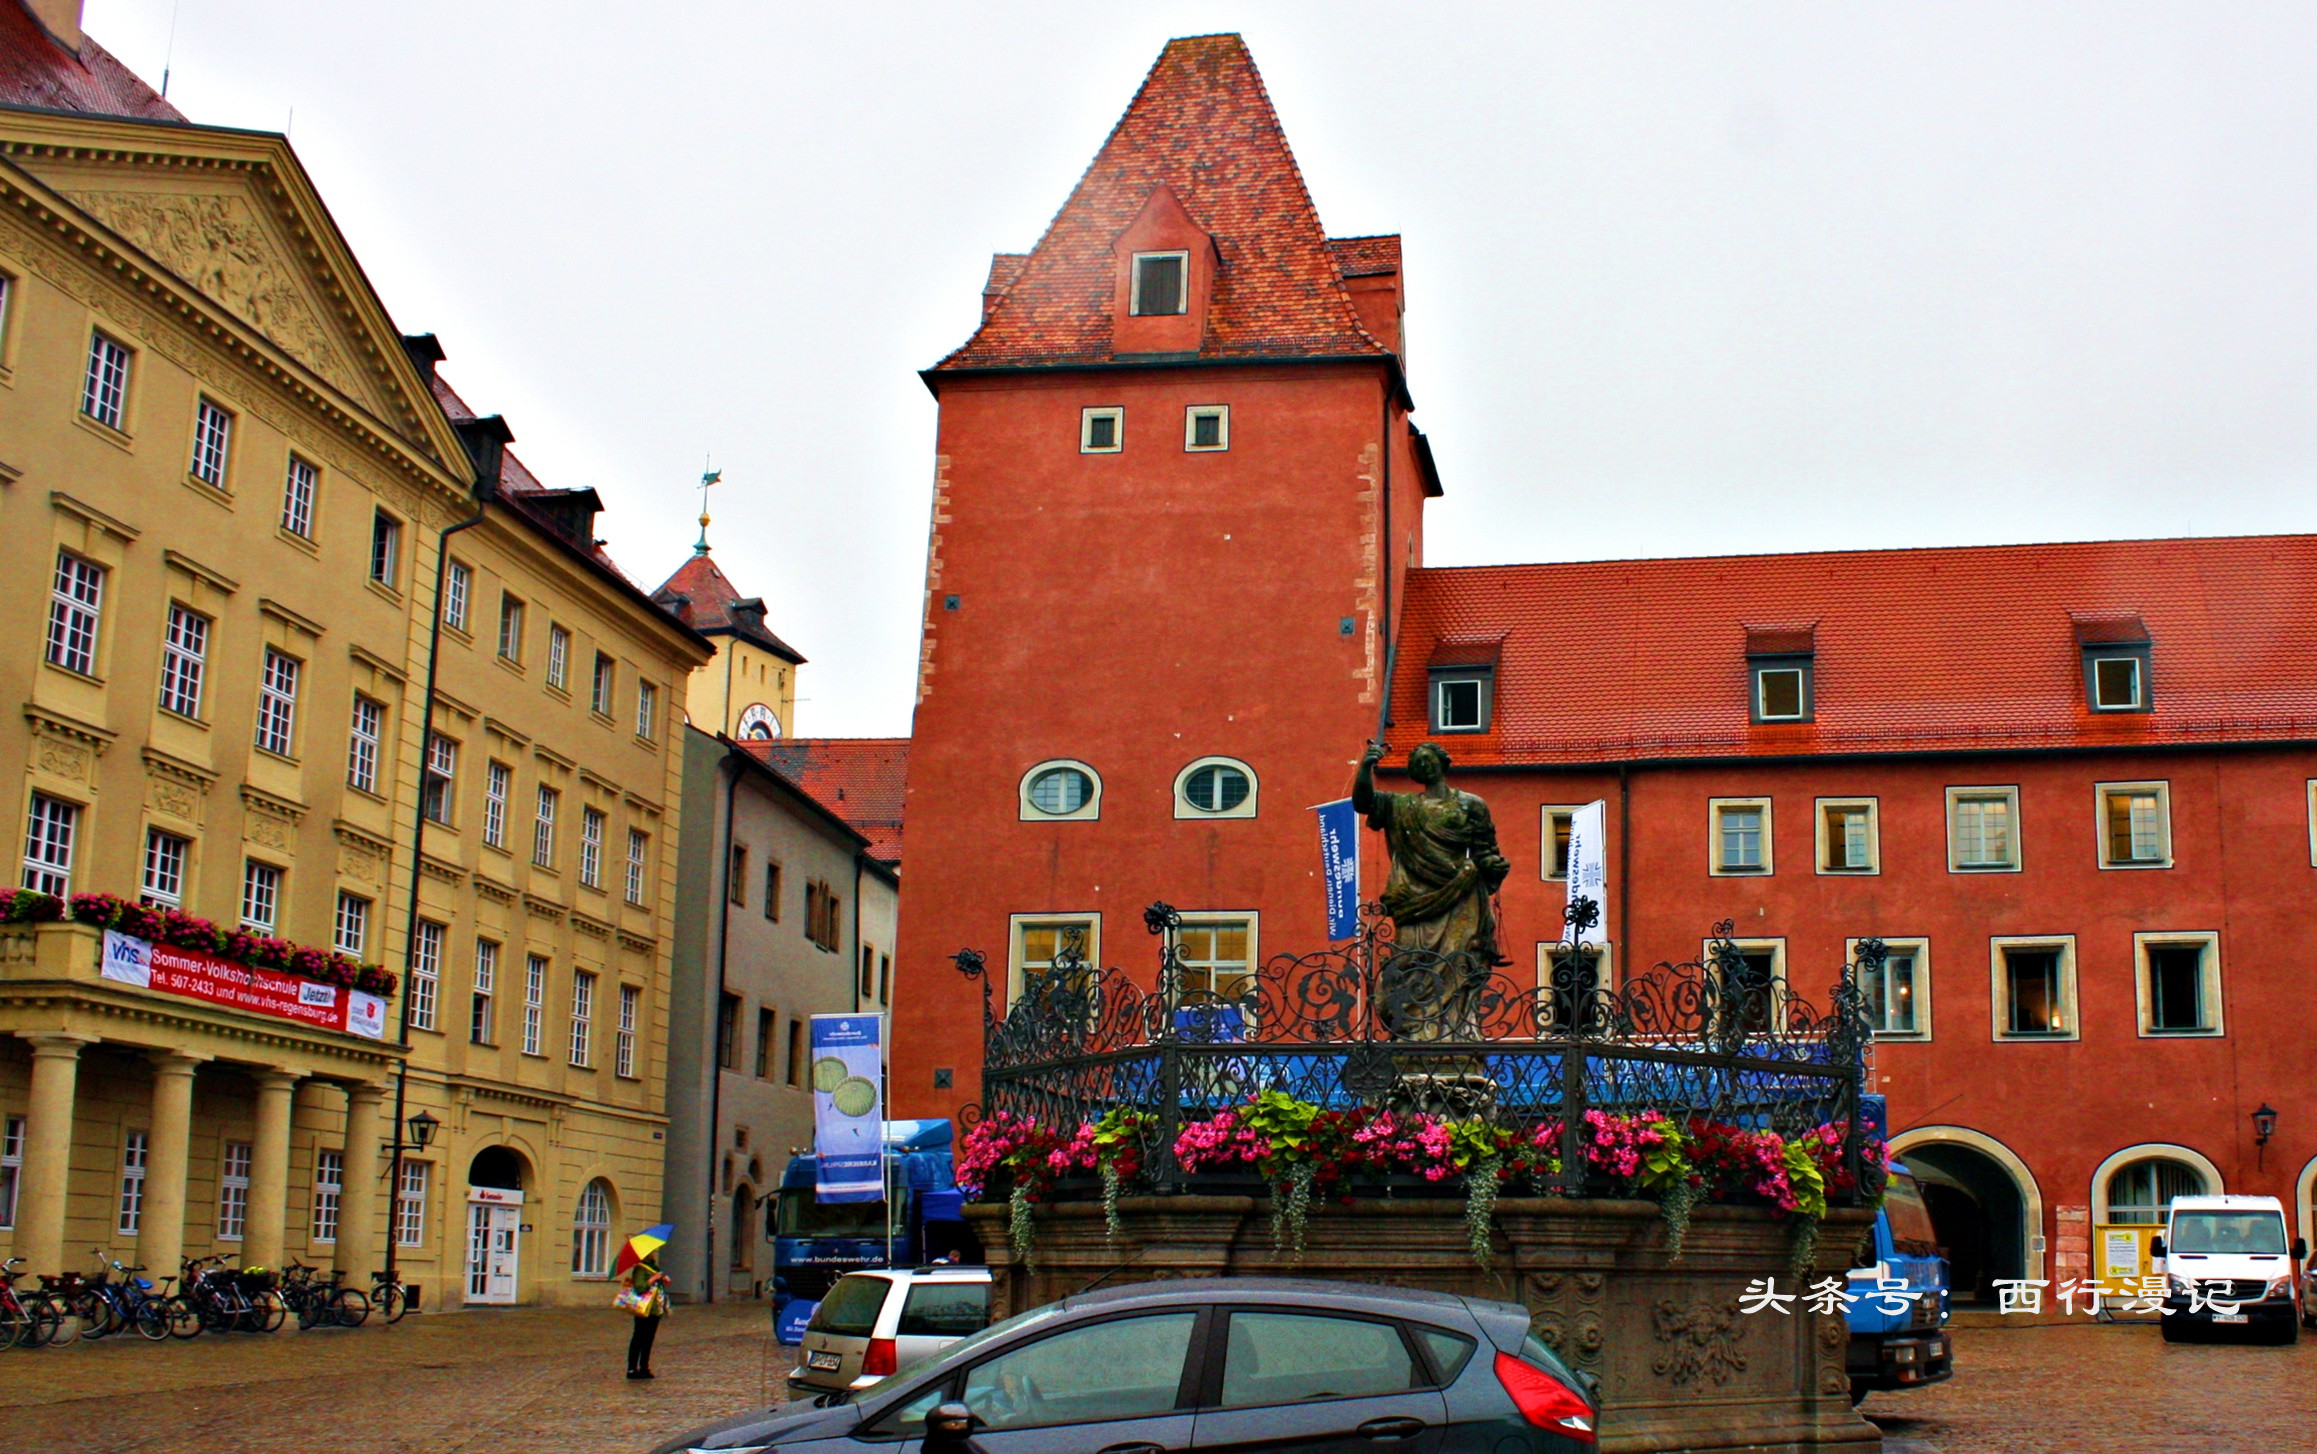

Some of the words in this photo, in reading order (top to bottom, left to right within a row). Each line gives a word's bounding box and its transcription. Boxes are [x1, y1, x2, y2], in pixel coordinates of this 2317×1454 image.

[152, 948, 298, 996] Sommer-Volkshochschule
[151, 969, 169, 985] Tel.
[170, 973, 215, 995] 507-2433
[216, 986, 236, 1001] und
[236, 991, 339, 1024] www.vhs-regensburg.de
[790, 1255, 884, 1264] www.bundeswehr.de
